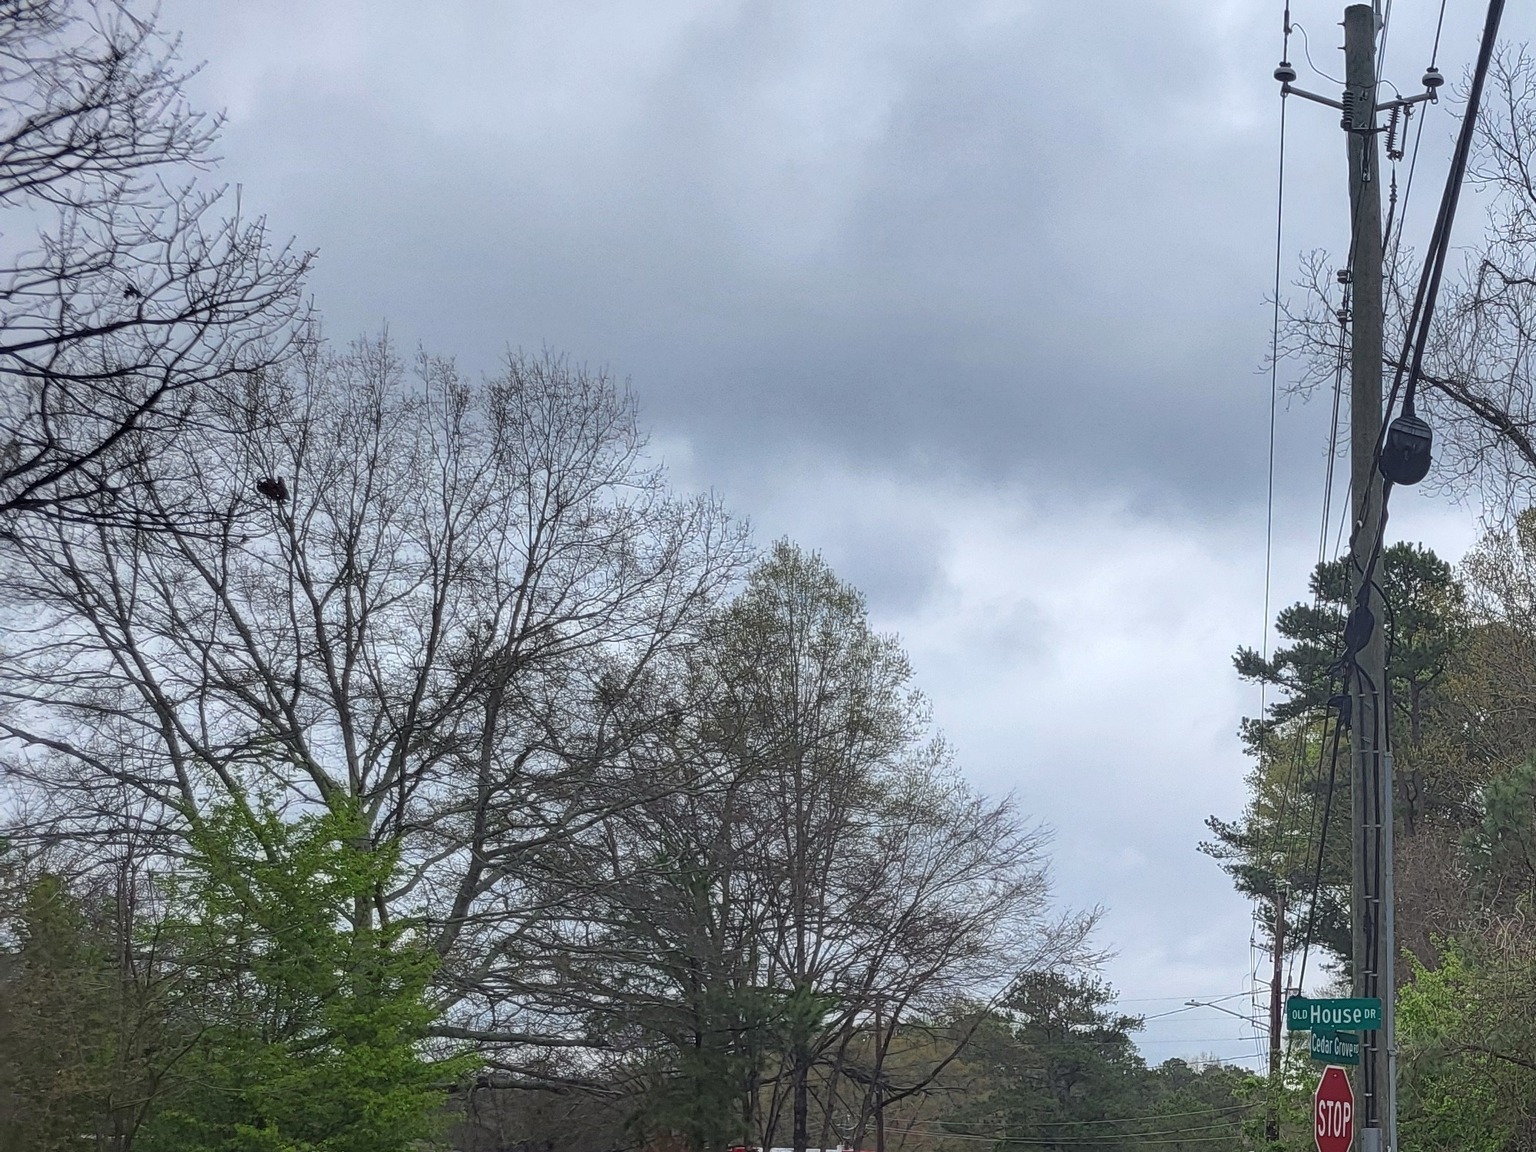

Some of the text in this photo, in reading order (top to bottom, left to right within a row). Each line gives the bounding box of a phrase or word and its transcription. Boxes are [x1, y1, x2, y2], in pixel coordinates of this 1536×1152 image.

[1292, 1004, 1376, 1024] OLD House DR
[1312, 1033, 1333, 1054] Cedar
[1335, 1037, 1353, 1057] Grove
[1318, 1099, 1351, 1138] STOP
